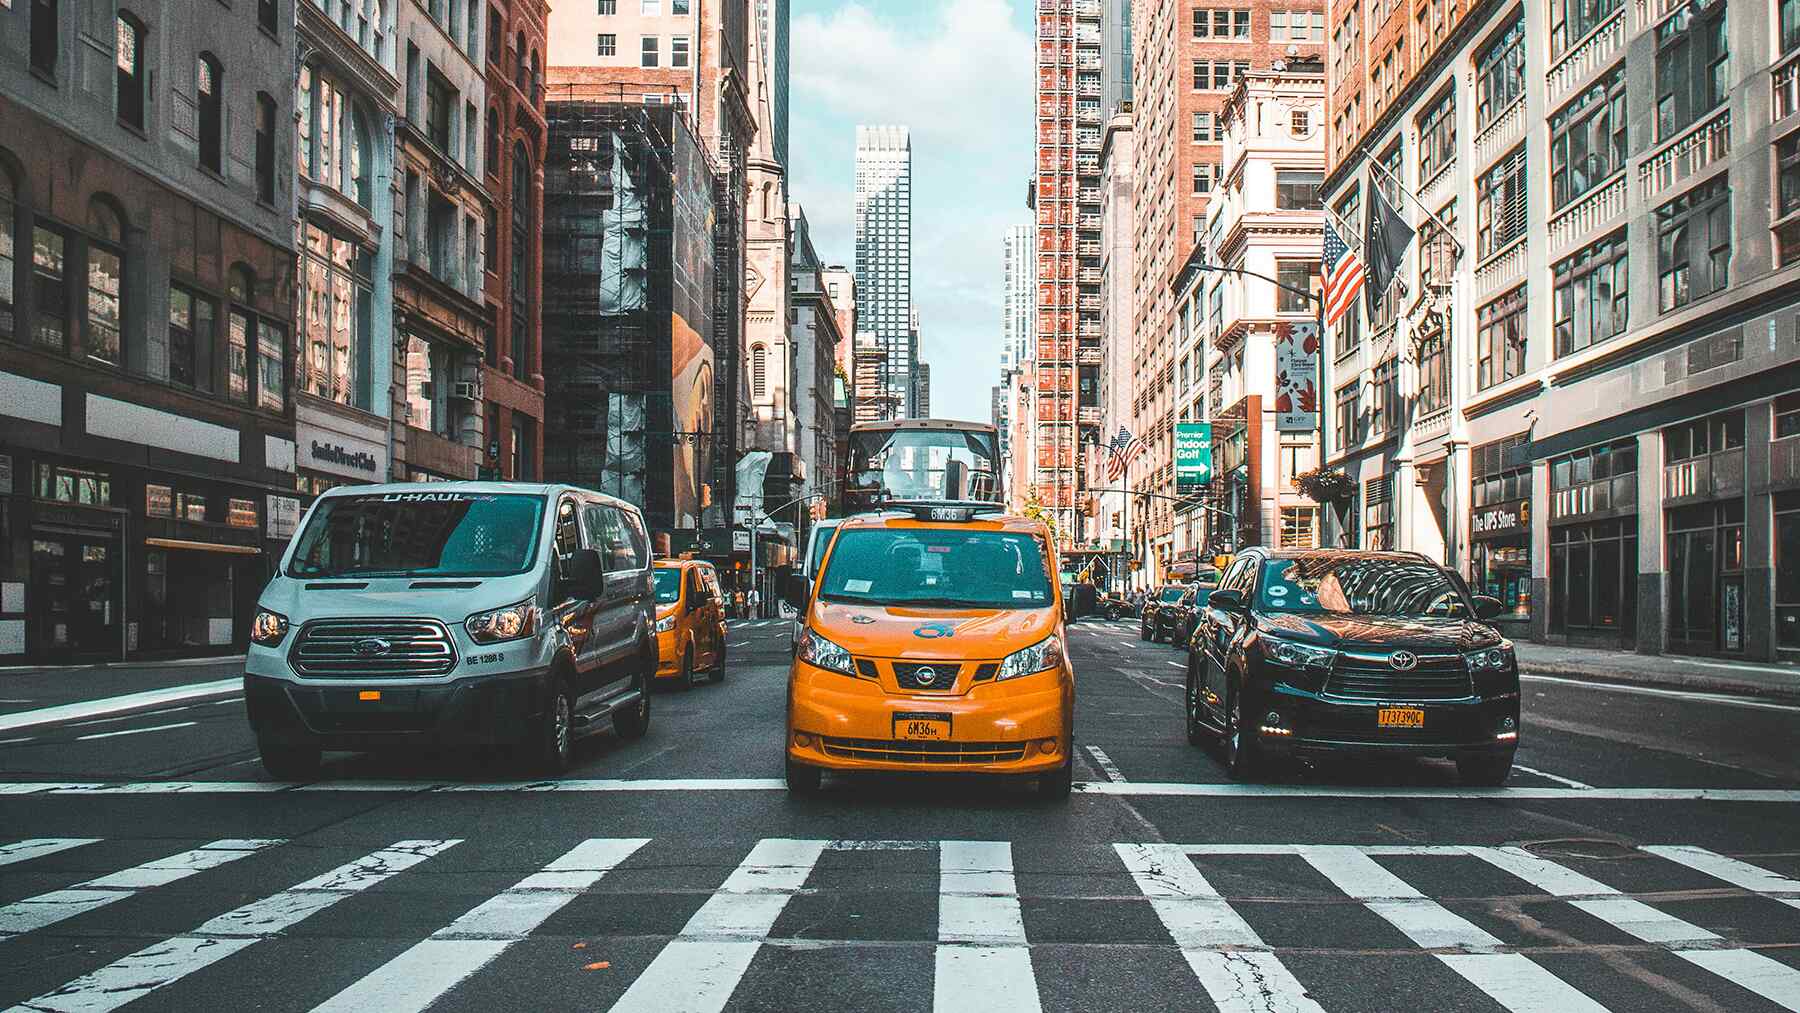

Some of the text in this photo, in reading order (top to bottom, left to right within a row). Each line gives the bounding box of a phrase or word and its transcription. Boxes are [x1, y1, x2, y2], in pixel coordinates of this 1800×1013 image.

[1177, 440, 1209, 448] Indoor
[312, 440, 375, 472] SmileDirectClub
[1177, 449, 1199, 459] Golf
[383, 493, 464, 502] U-HAUL
[931, 508, 957, 520] 6M36
[1472, 510, 1515, 532] The UPS Store
[466, 656, 478, 665] BE
